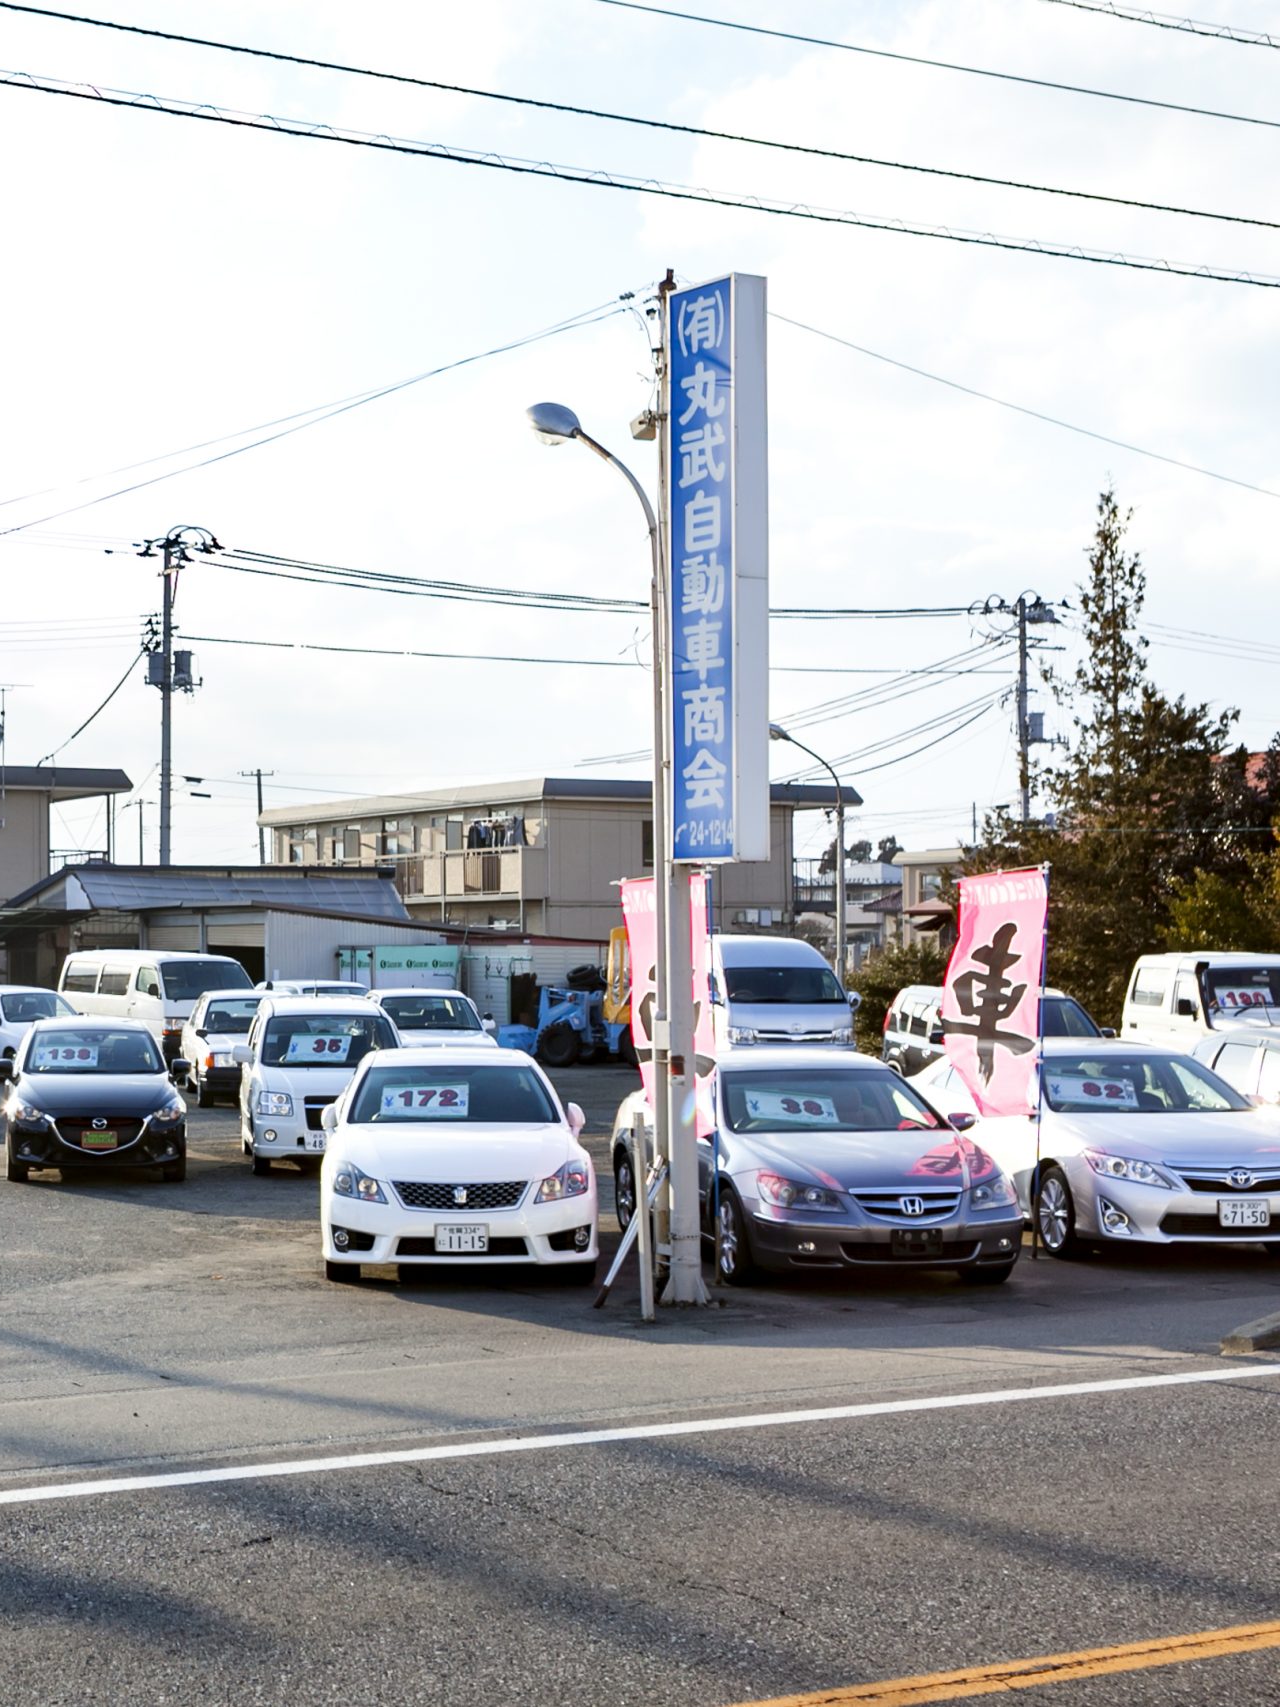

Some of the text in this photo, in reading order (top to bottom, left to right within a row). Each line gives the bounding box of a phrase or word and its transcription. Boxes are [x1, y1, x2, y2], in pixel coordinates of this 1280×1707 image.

[677, 290, 726, 809] (有)丸武自動車商会
[940, 922, 1036, 1088] 車
[398, 1089, 459, 1107] 172
[1231, 1211, 1267, 1224] 71-50
[449, 1236, 486, 1249] 11-15
